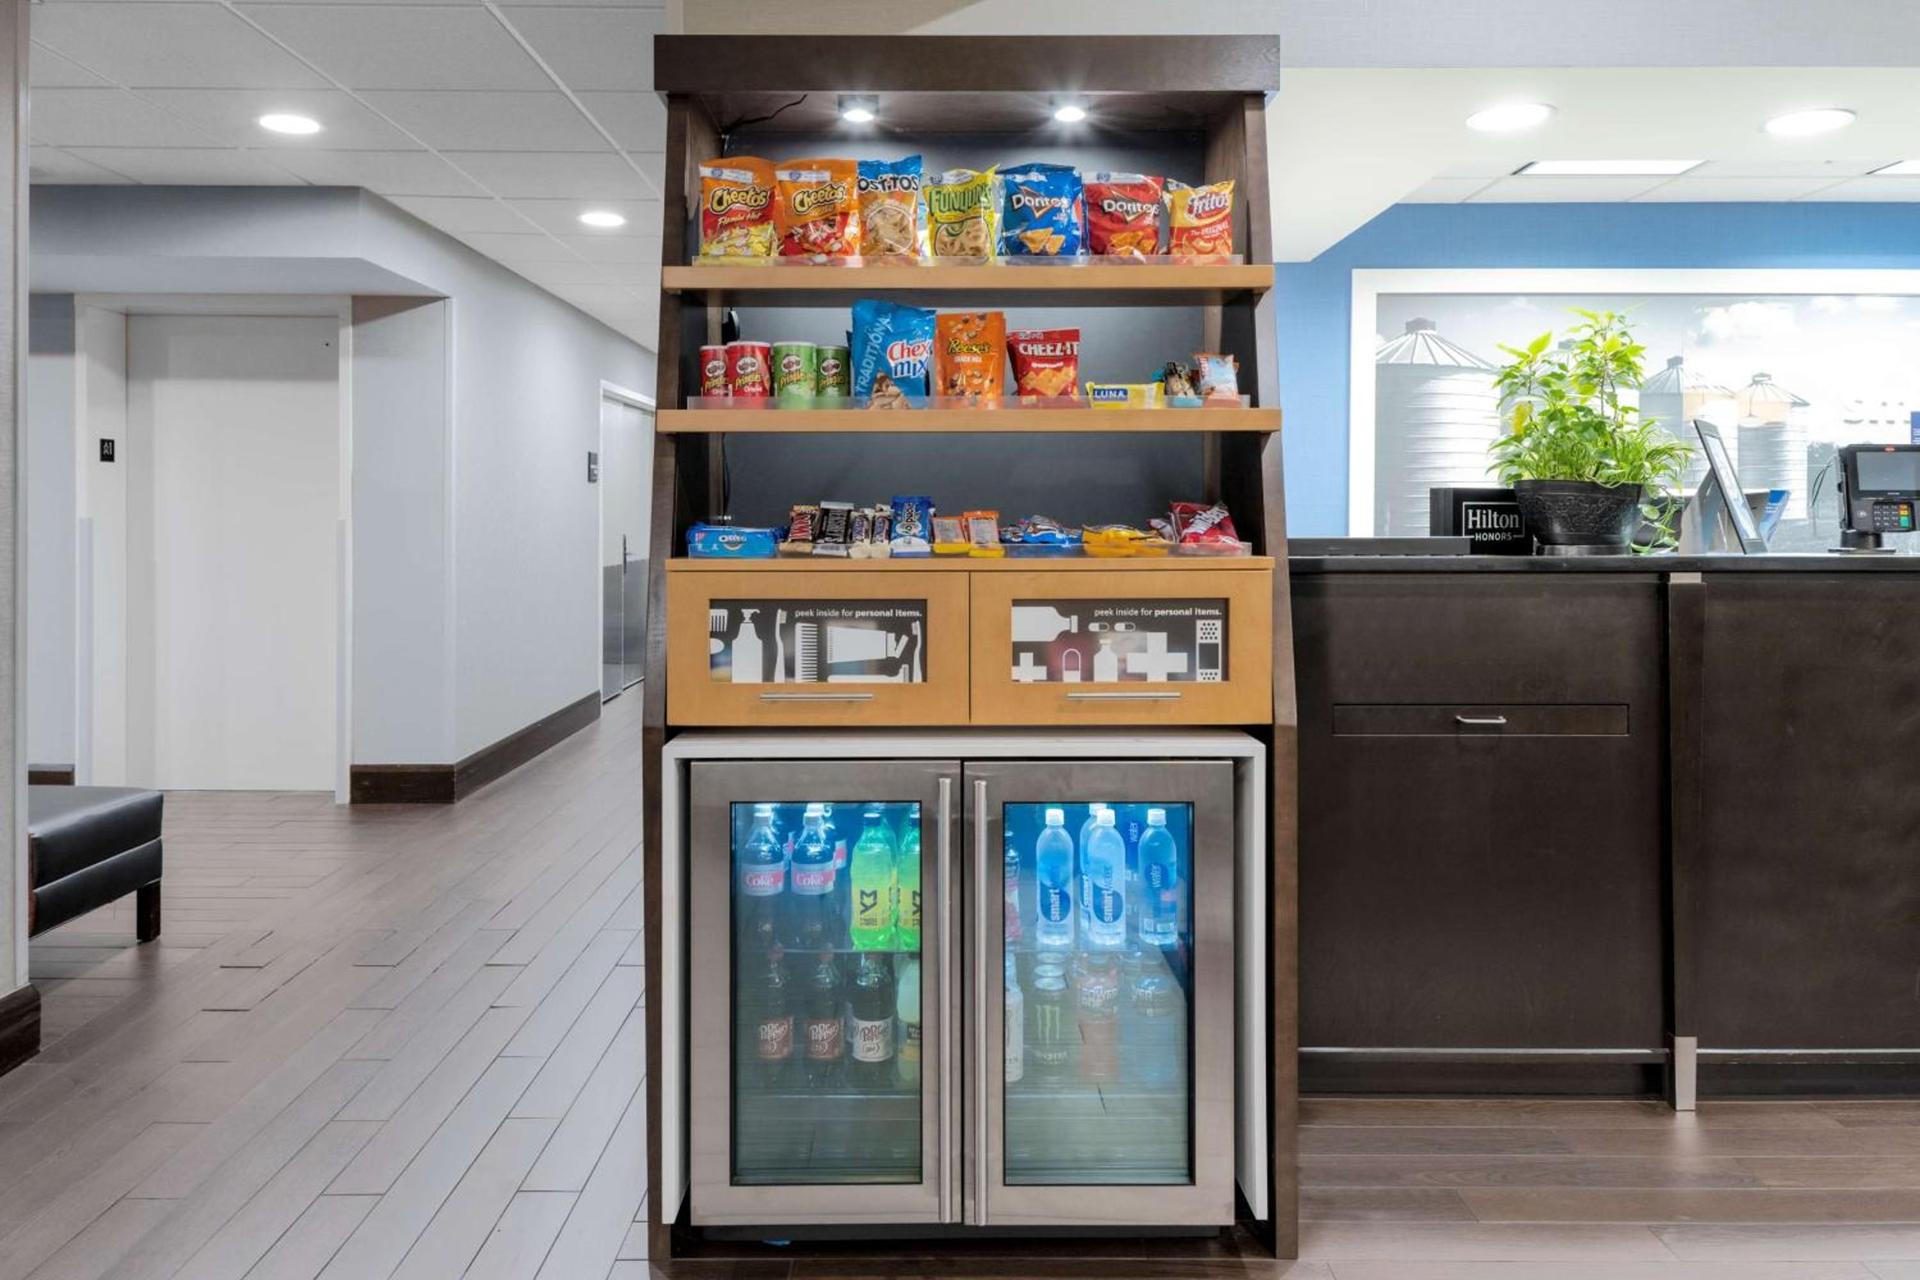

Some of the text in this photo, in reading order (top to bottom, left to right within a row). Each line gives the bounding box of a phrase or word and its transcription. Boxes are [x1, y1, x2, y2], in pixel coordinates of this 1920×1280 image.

[711, 187, 769, 213] Cheetos
[793, 183, 846, 213] Cheetos
[888, 340, 931, 362] Chex
[1094, 389, 1124, 399] LUNA
[1467, 509, 1520, 529] Hilton
[1475, 532, 1513, 541] HONORS
[795, 608, 922, 618] peek inside for personal items.
[1094, 607, 1222, 617] peek inside for personal items.
[1049, 887, 1060, 921] smart
